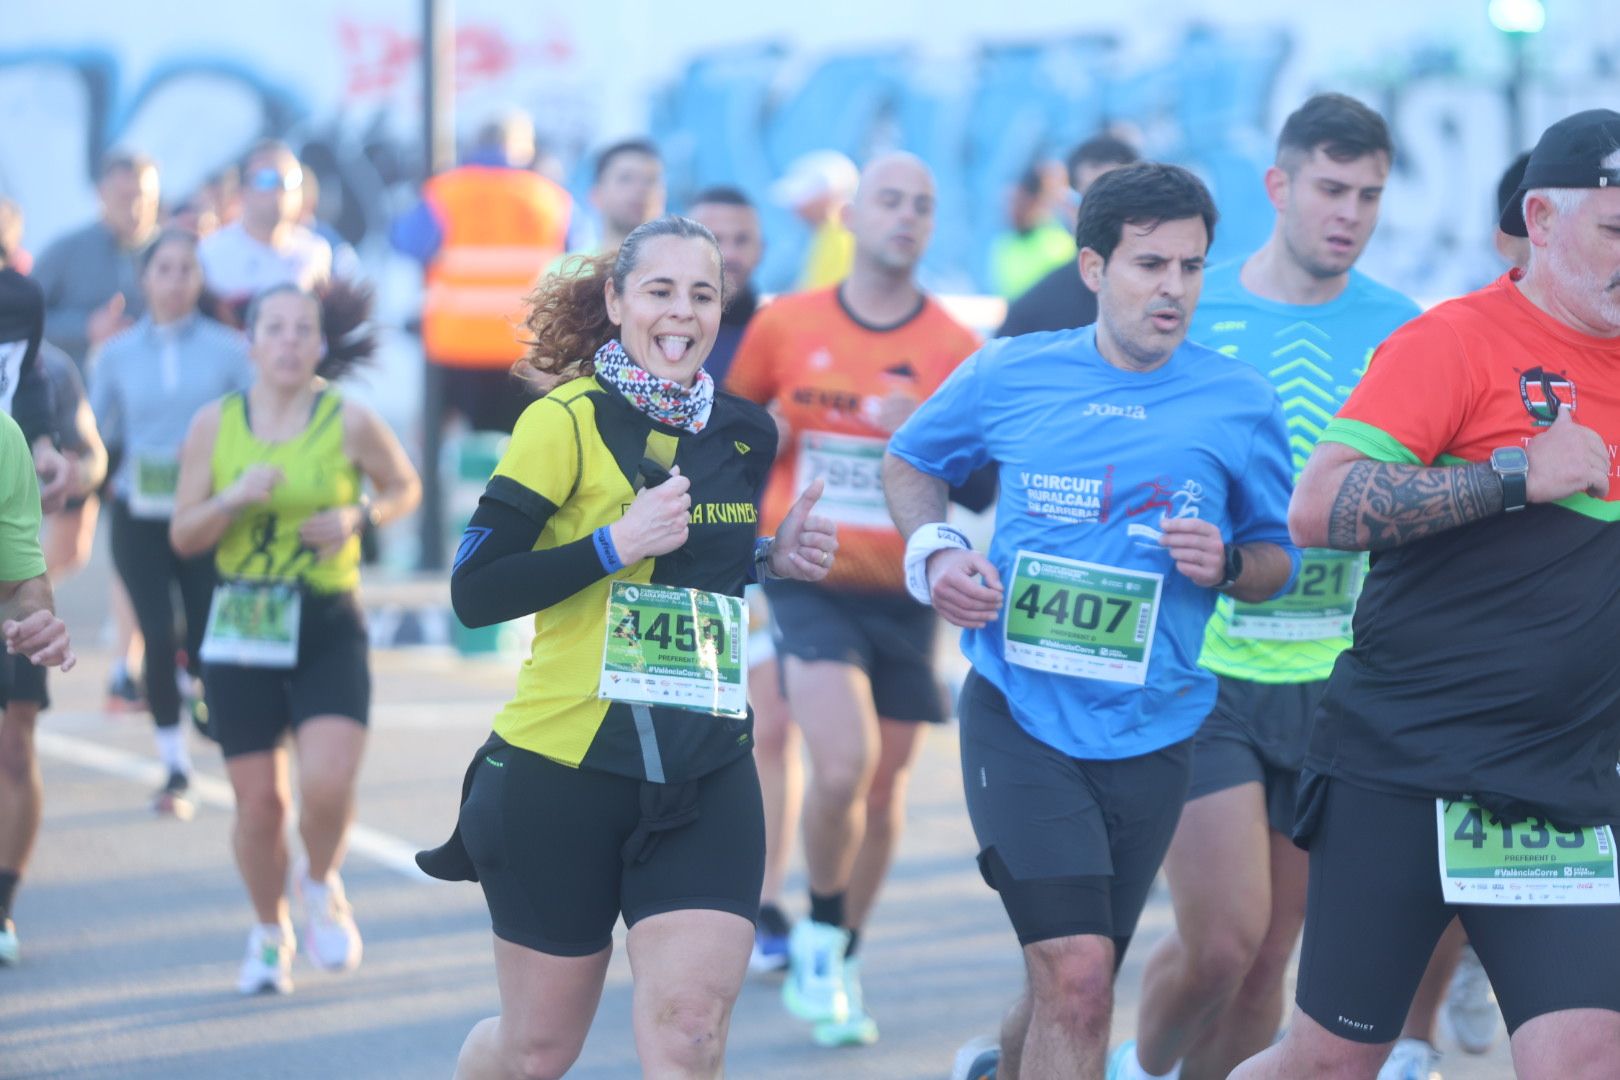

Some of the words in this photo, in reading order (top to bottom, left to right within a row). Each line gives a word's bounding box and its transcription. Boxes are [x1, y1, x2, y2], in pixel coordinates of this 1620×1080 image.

[1083, 402, 1147, 420] Joma
[1021, 471, 1030, 487] V
[1032, 473, 1103, 494] CIRCUIT
[1027, 488, 1101, 509] RURALCAJA
[1042, 503, 1100, 518] CARRERAS
[1015, 583, 1133, 634] 4407
[613, 608, 726, 656] 4459
[658, 654, 695, 664] PREFERENT
[1504, 854, 1549, 862] PREFERENT
[1494, 867, 1559, 878] #ValènciaCorre
[1338, 1015, 1375, 1031] EVADICT
